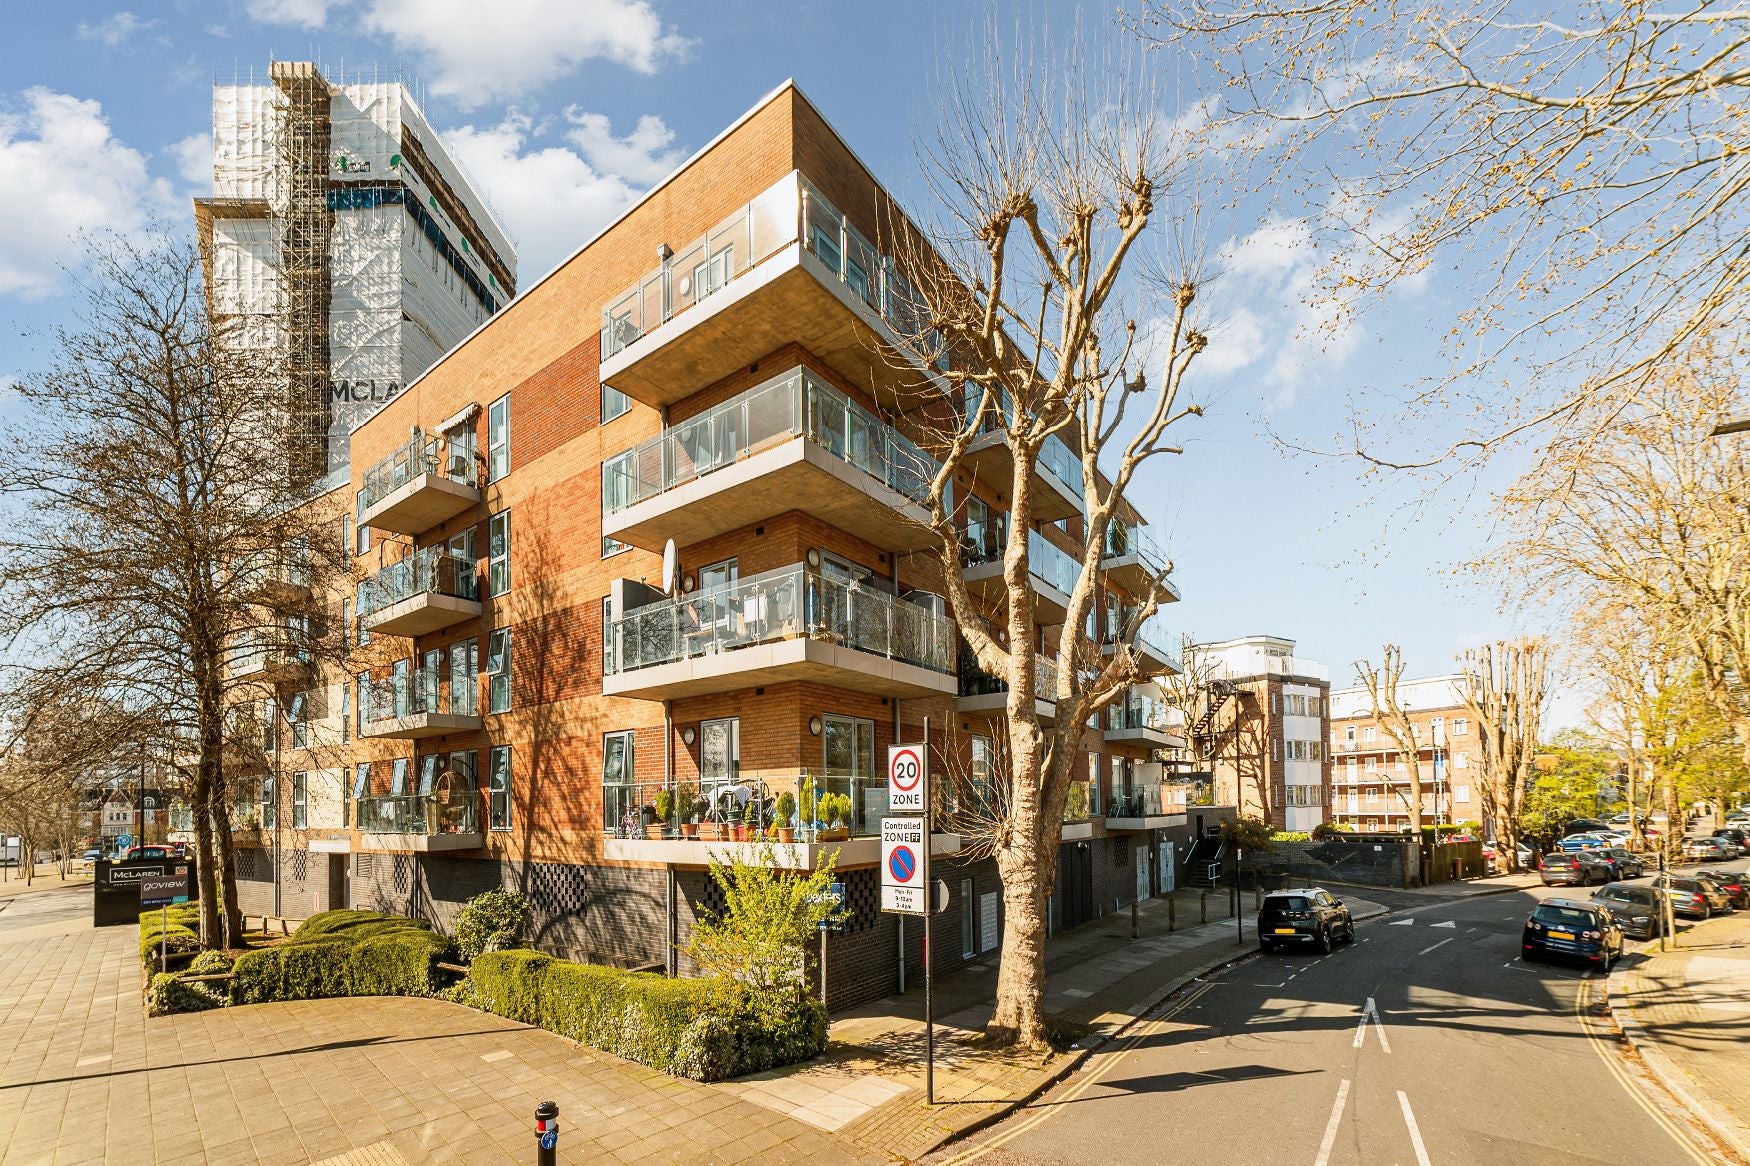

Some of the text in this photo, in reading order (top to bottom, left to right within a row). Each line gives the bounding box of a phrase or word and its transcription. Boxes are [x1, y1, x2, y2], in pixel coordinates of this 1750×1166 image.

[328, 379, 407, 402] MCLA
[896, 761, 917, 779] 20
[893, 794, 920, 805] ZONE
[884, 821, 921, 830] Controlled
[884, 832, 920, 843] ZONE FF
[143, 880, 186, 891] goview
